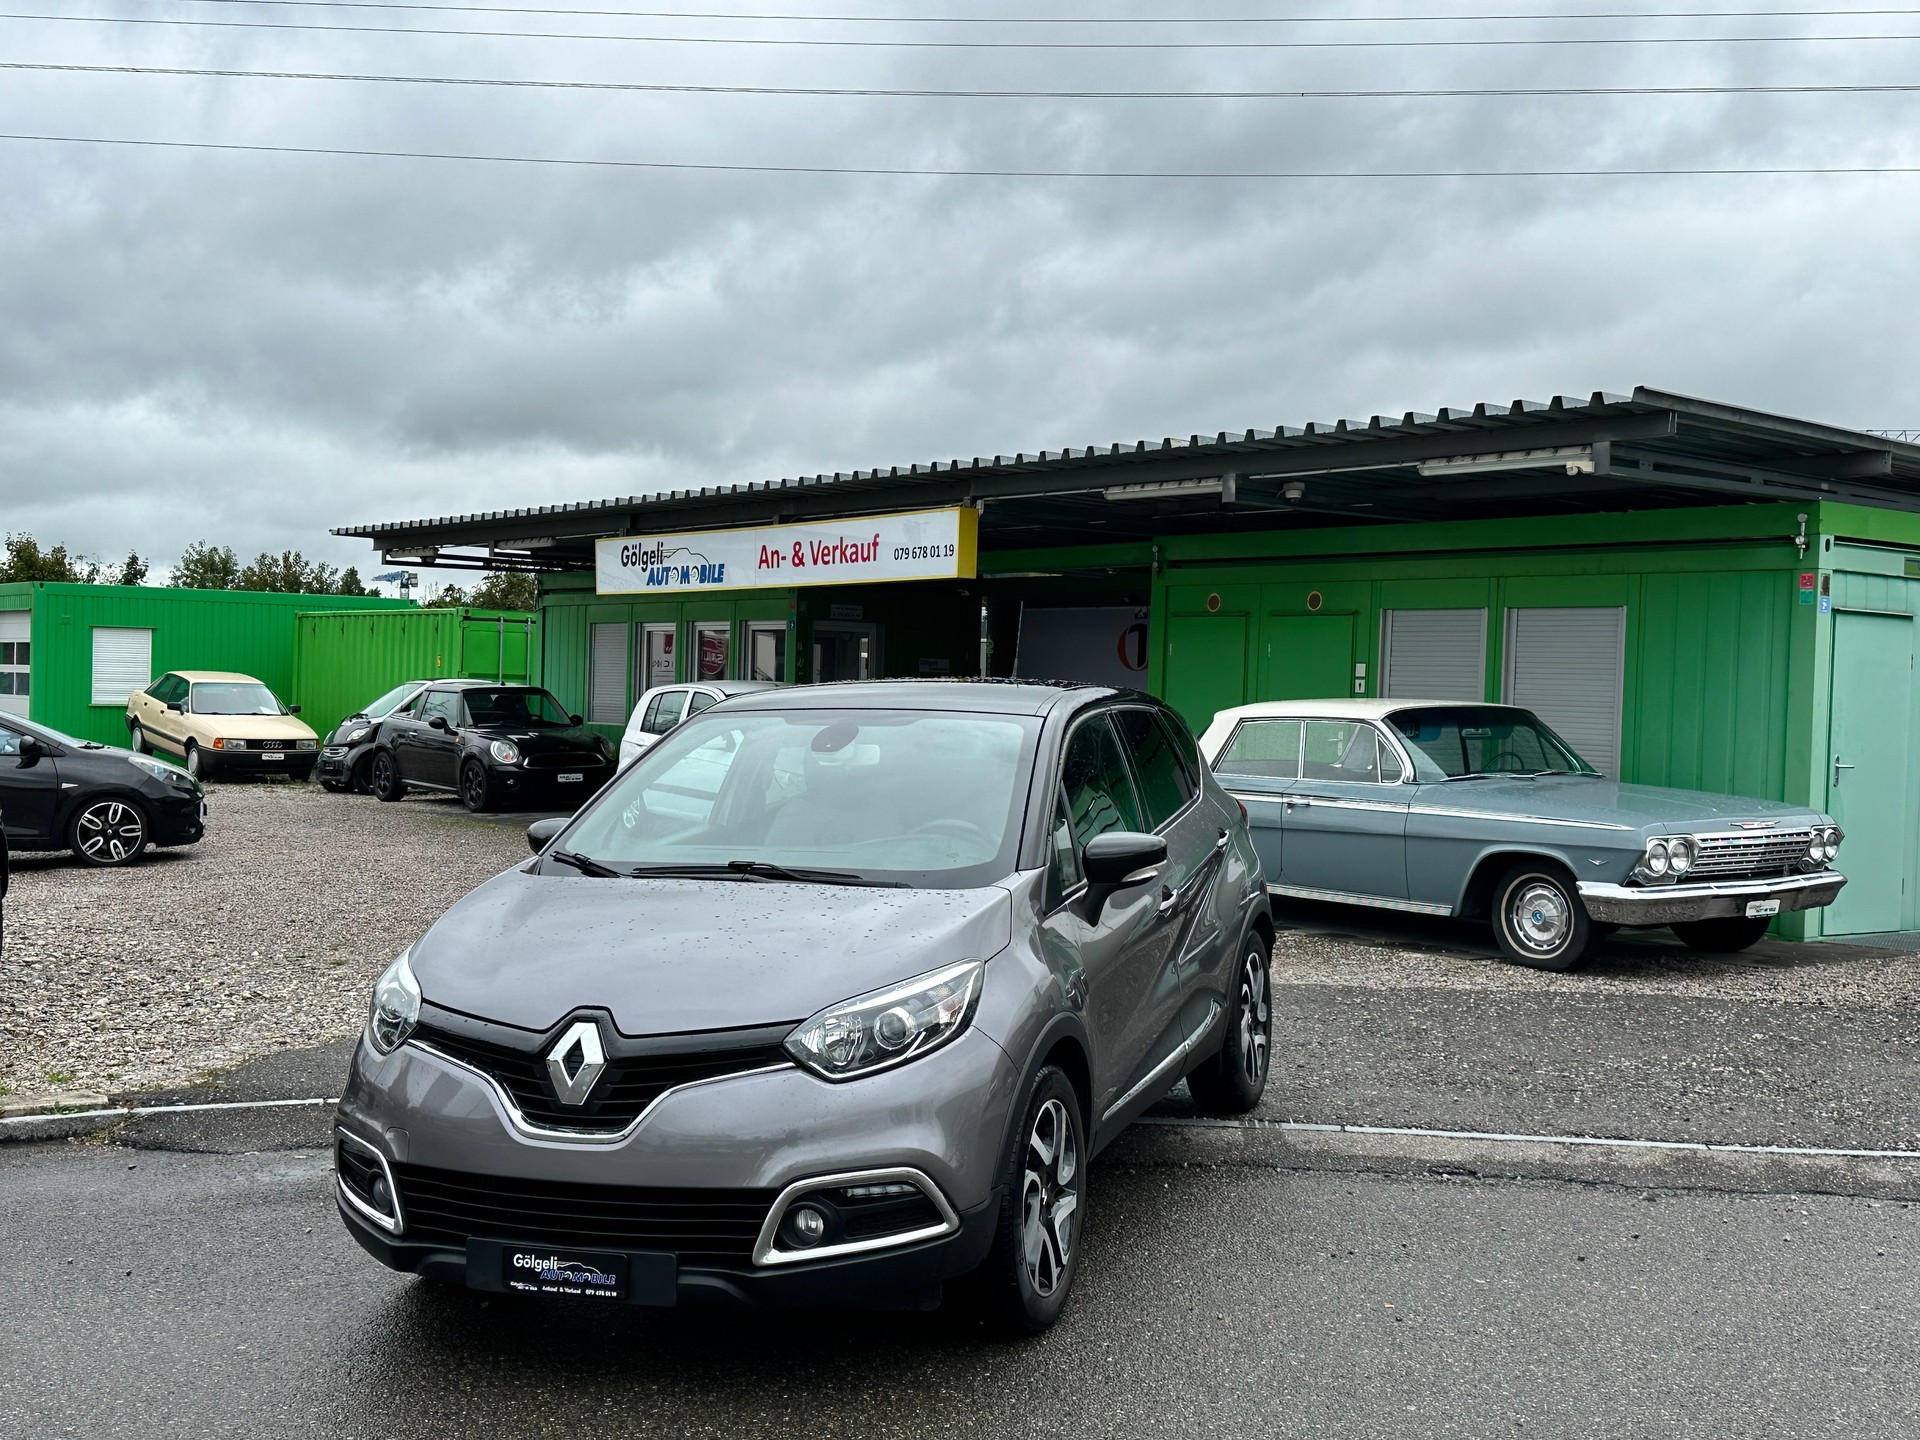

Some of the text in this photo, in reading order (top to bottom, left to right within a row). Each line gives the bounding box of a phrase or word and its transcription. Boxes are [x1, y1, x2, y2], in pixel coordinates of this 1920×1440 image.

[621, 541, 664, 573] Gölgeli
[758, 533, 880, 569] An- & Verkauf
[893, 543, 955, 561] 079 678 01 19
[646, 563, 725, 586] AUTOMOBILE
[513, 1253, 558, 1272] Gölgeli
[540, 1269, 617, 1286] AUTOMOBILE
